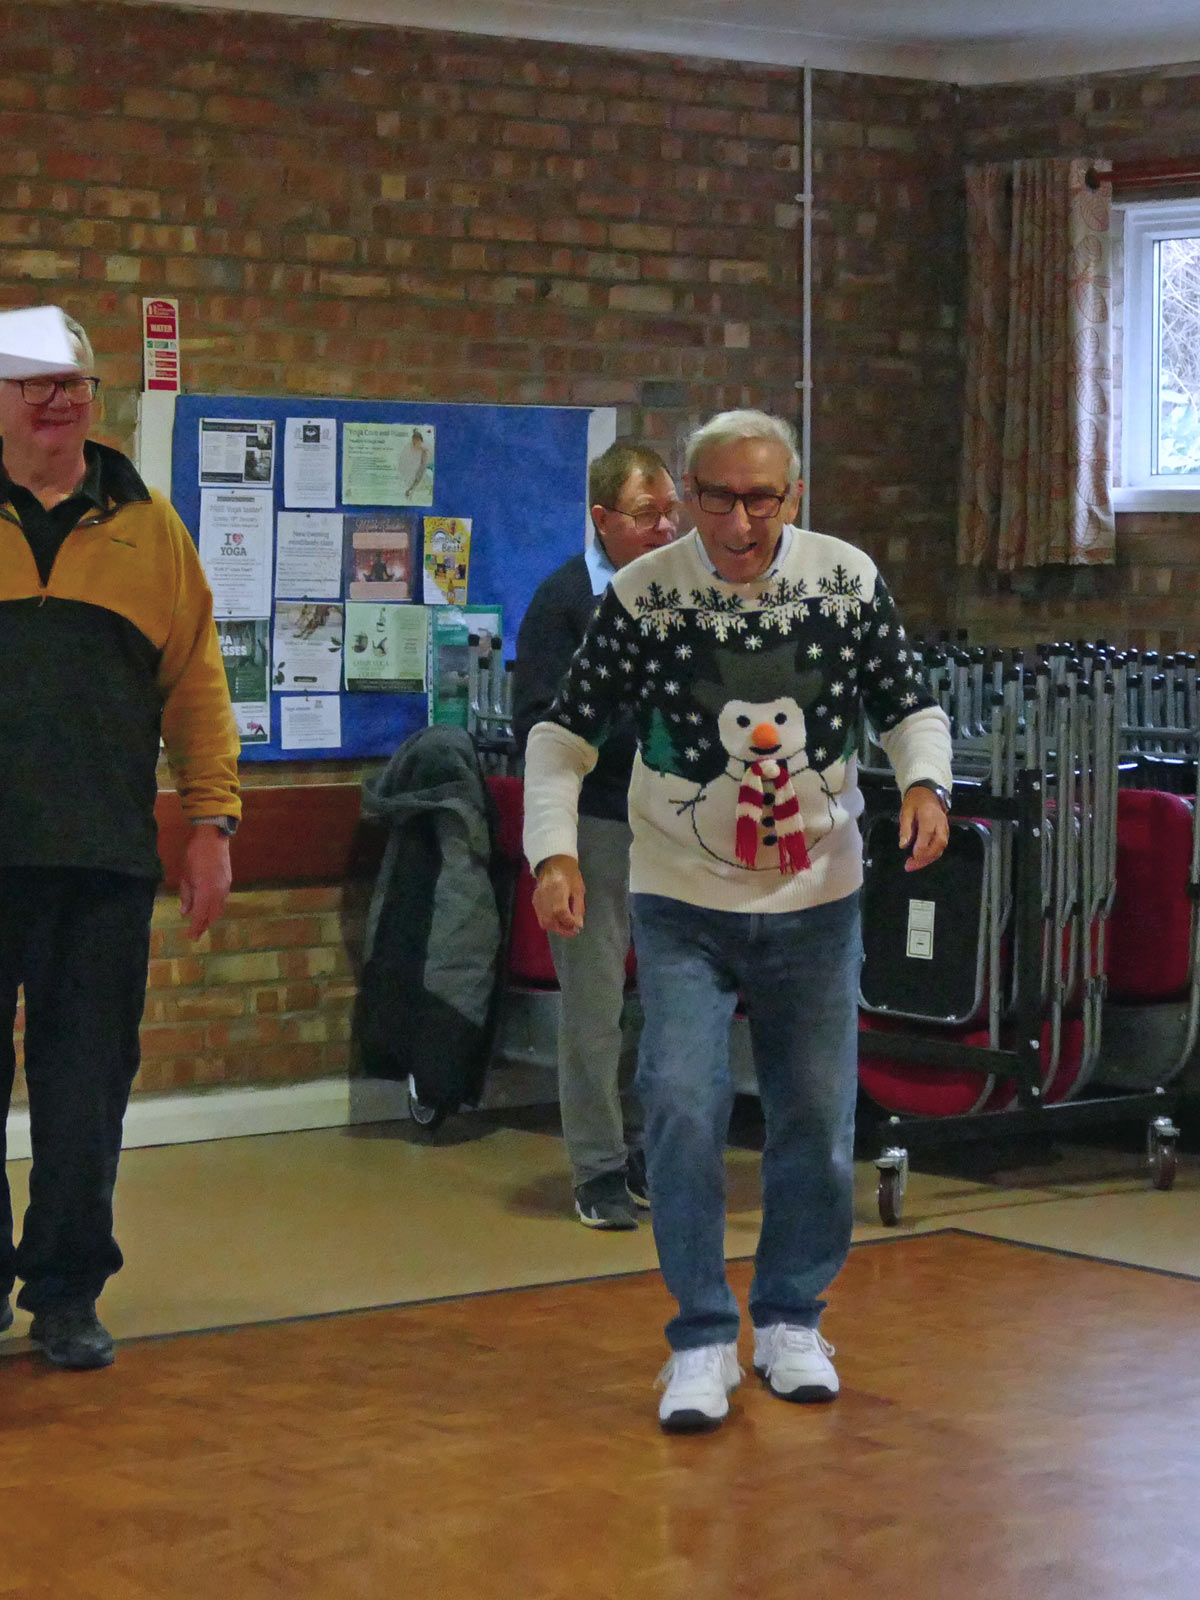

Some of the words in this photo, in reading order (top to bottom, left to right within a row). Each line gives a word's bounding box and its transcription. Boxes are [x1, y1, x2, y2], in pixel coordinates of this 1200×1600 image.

[150, 323, 173, 333] WATER
[224, 533, 232, 545] I
[220, 546, 247, 556] YOGA
[442, 543, 464, 553] Beats
